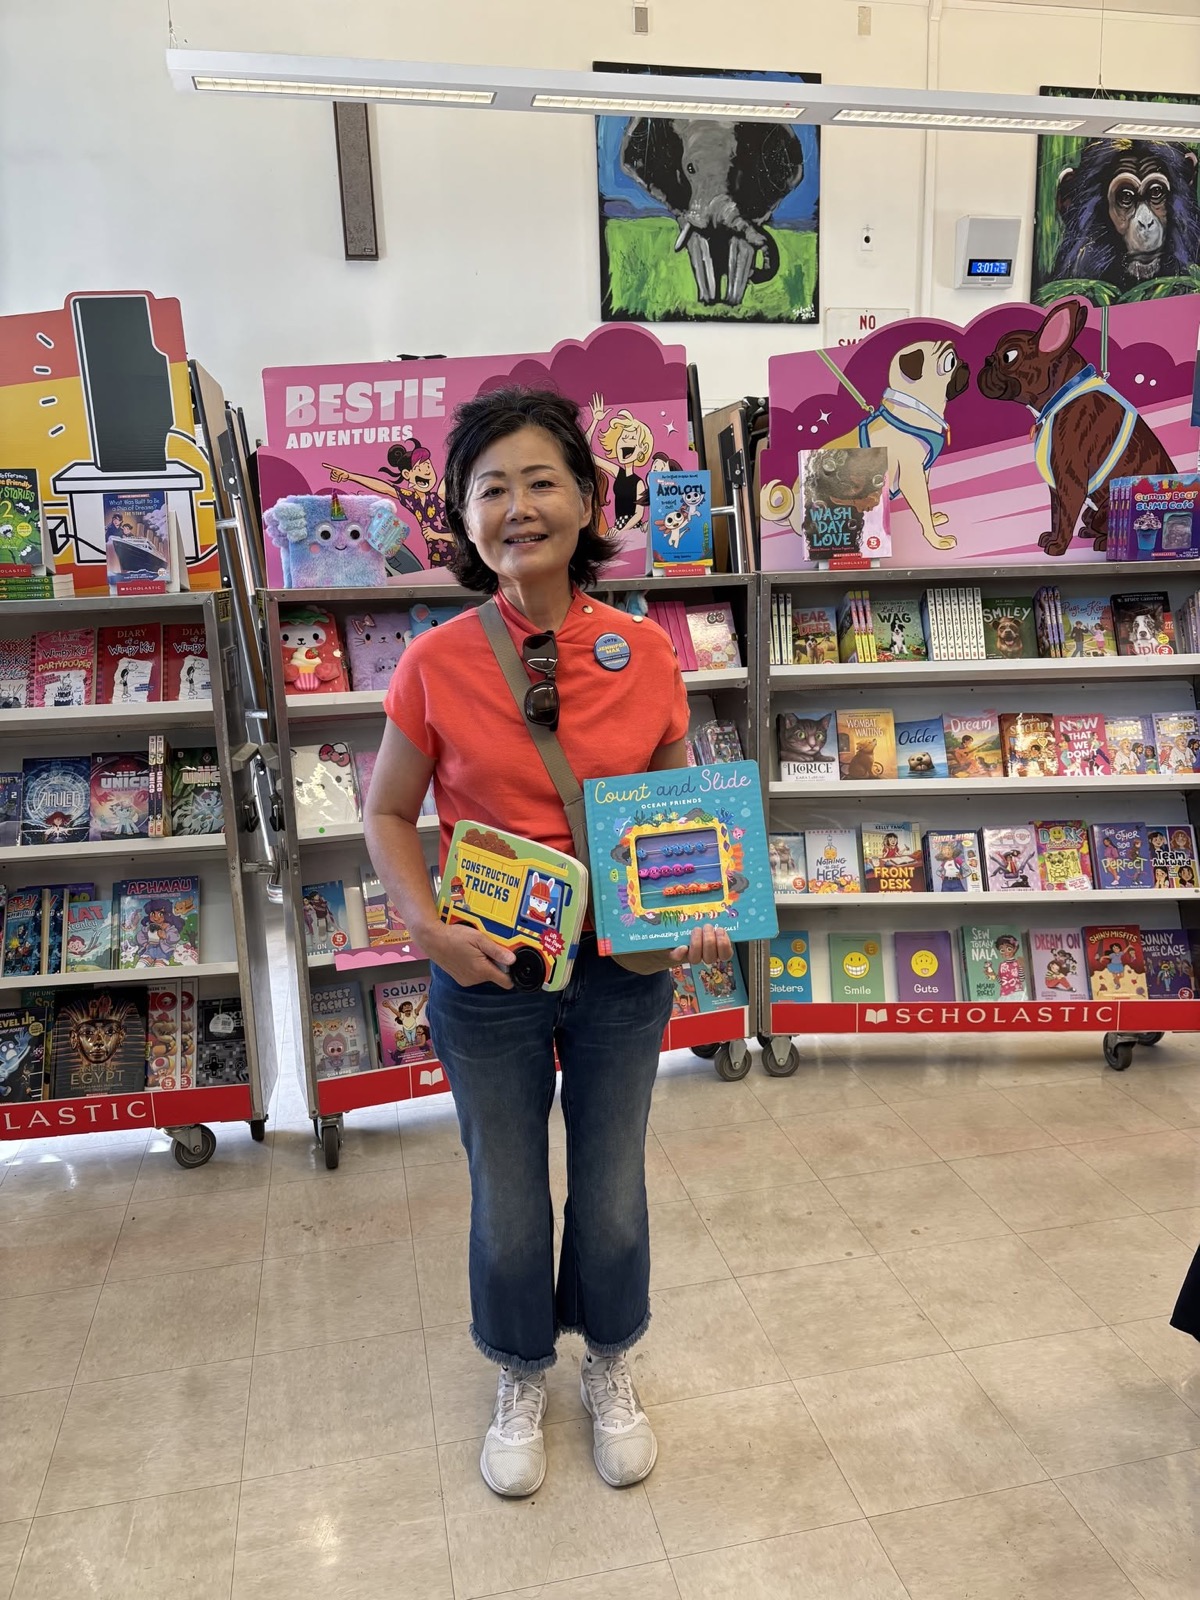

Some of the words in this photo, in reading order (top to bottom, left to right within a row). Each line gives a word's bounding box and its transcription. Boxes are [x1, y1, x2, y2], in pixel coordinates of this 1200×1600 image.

[976, 262, 993, 273] 3:01
[860, 315, 876, 330] NO
[286, 377, 446, 427] BESTIE
[286, 425, 413, 449] ADVENTURES
[4, 486, 35, 502] STORIES
[657, 484, 705, 496] AXOLOTL
[1134, 492, 1172, 501] Gummy
[1172, 491, 1198, 500] Bear
[1, 500, 13, 518] 2
[810, 507, 852, 520] WASH
[818, 520, 845, 534] DAY
[812, 533, 852, 547] LOVE
[880, 605, 894, 613] Let
[982, 607, 1031, 624] SMILEY
[793, 611, 828, 625] NEAR
[877, 612, 912, 623] WAG
[118, 628, 147, 638] DIARY
[42, 647, 72, 659] Wimpy
[73, 645, 88, 656] Kid
[107, 644, 139, 656] Wimpy
[139, 641, 155, 653] Kid
[173, 642, 205, 654] Wimpy
[1126, 644, 1158, 656] Ripl
[846, 718, 876, 728] WOMBAT
[950, 718, 992, 732] Dream
[1010, 723, 1035, 735] SICE
[1037, 722, 1049, 732] UP
[1060, 717, 1099, 732] NOW
[855, 728, 883, 737] WAITING
[898, 727, 939, 745] Odder
[1068, 731, 1092, 740] THAT
[1073, 741, 1089, 749] WE
[1063, 765, 1105, 776] TALK
[594, 782, 651, 804] Count
[656, 776, 696, 797] and
[700, 769, 751, 793] Slide
[11, 791, 17, 799] 2
[36, 790, 80, 811] AMULET
[669, 798, 702, 806] FRIENDS
[1156, 850, 1186, 860] Team
[460, 858, 520, 889] CONSTRUCTION
[816, 866, 847, 881] HERE
[874, 867, 915, 878] FRONT
[127, 879, 192, 895] APHMAU
[465, 874, 510, 902] TRUCKS
[880, 879, 912, 889] DESK
[649, 931, 679, 941] amazing
[972, 928, 990, 940] SEW
[1089, 931, 1110, 944] SHINY
[1110, 930, 1138, 943] MISFITS
[1140, 933, 1174, 945] SUNNY
[1034, 934, 1063, 950] DREAM
[1067, 933, 1081, 949] ON
[971, 948, 998, 961] NALA
[1160, 944, 1187, 957] CASE
[383, 983, 427, 998] SQUAD
[770, 983, 804, 992] Sisters
[844, 985, 871, 995] Smile
[913, 984, 939, 993] Guts
[896, 1006, 1113, 1024] SCHOLASTIC
[70, 1069, 125, 1085] EGYPT
[164, 1079, 172, 1087] 5
[4, 1101, 147, 1131] LASTIC
